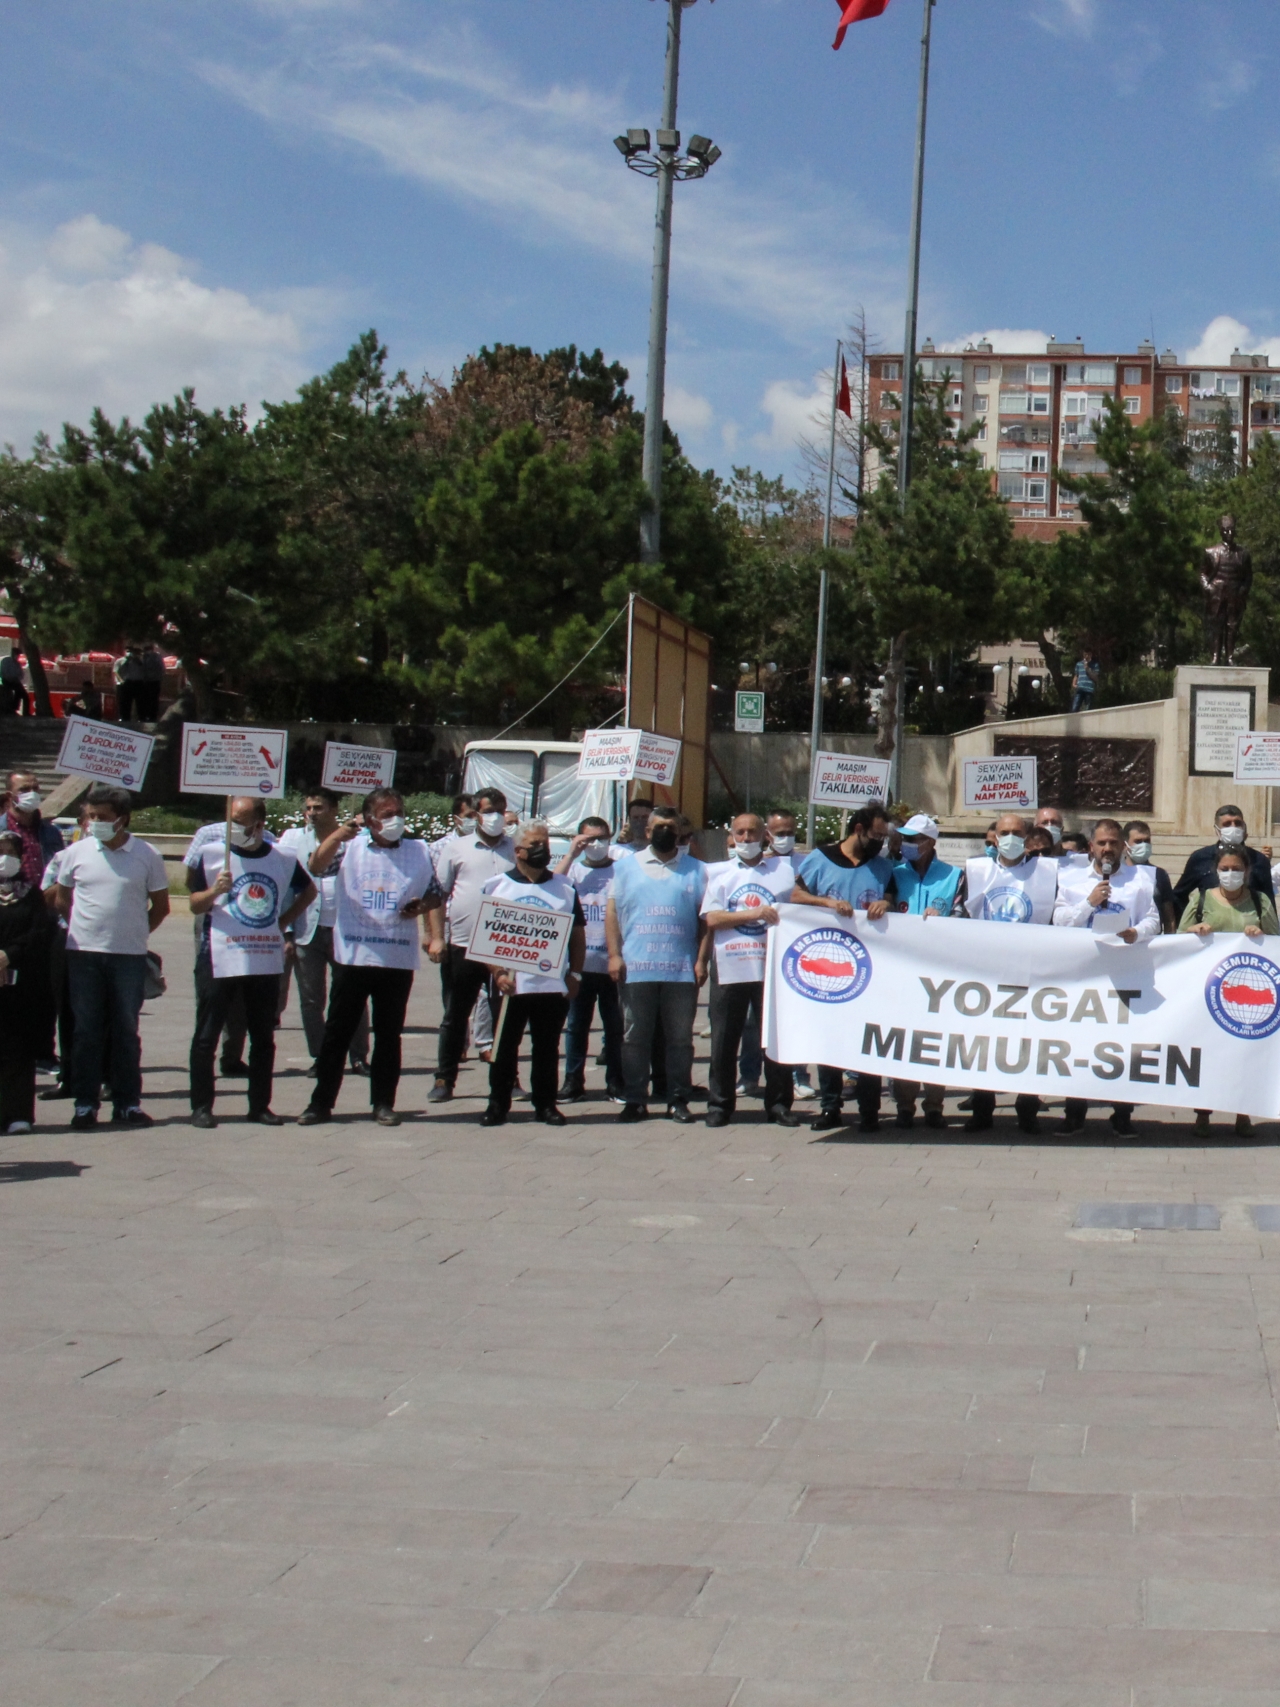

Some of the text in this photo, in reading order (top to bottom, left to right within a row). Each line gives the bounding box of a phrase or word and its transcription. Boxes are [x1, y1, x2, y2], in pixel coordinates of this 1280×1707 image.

[82, 734, 136, 753] DURDURUN
[599, 737, 622, 746] MAAŞIM
[80, 752, 130, 769] ENFLASYONA
[340, 751, 382, 760] SEYYANEN
[585, 754, 633, 768] TAKILMASIN
[86, 762, 121, 775] UYDURUN
[341, 769, 377, 777] ALEMDE
[837, 763, 867, 773] MAAŞIM
[978, 763, 1021, 773] SEYYANEN
[822, 773, 880, 784] GELİR VERGİSİNE
[998, 772, 1023, 782] YAPIN
[820, 782, 883, 796] TAKILMASIN
[981, 782, 1018, 792] ALEMDE
[998, 790, 1026, 799] YAPIN
[494, 908, 557, 926] ENFLASYON
[484, 920, 559, 940] YÜKSELİYOR
[489, 932, 549, 949] MAAŞLAR
[646, 943, 658, 952] BU
[794, 931, 866, 960] MEMUR-SEN
[494, 946, 539, 961] ERİYOR
[918, 976, 1142, 1024] YOZGAT
[1210, 986, 1218, 1010] MEMUR
[861, 1022, 1202, 1088] MEMUR-SEN
